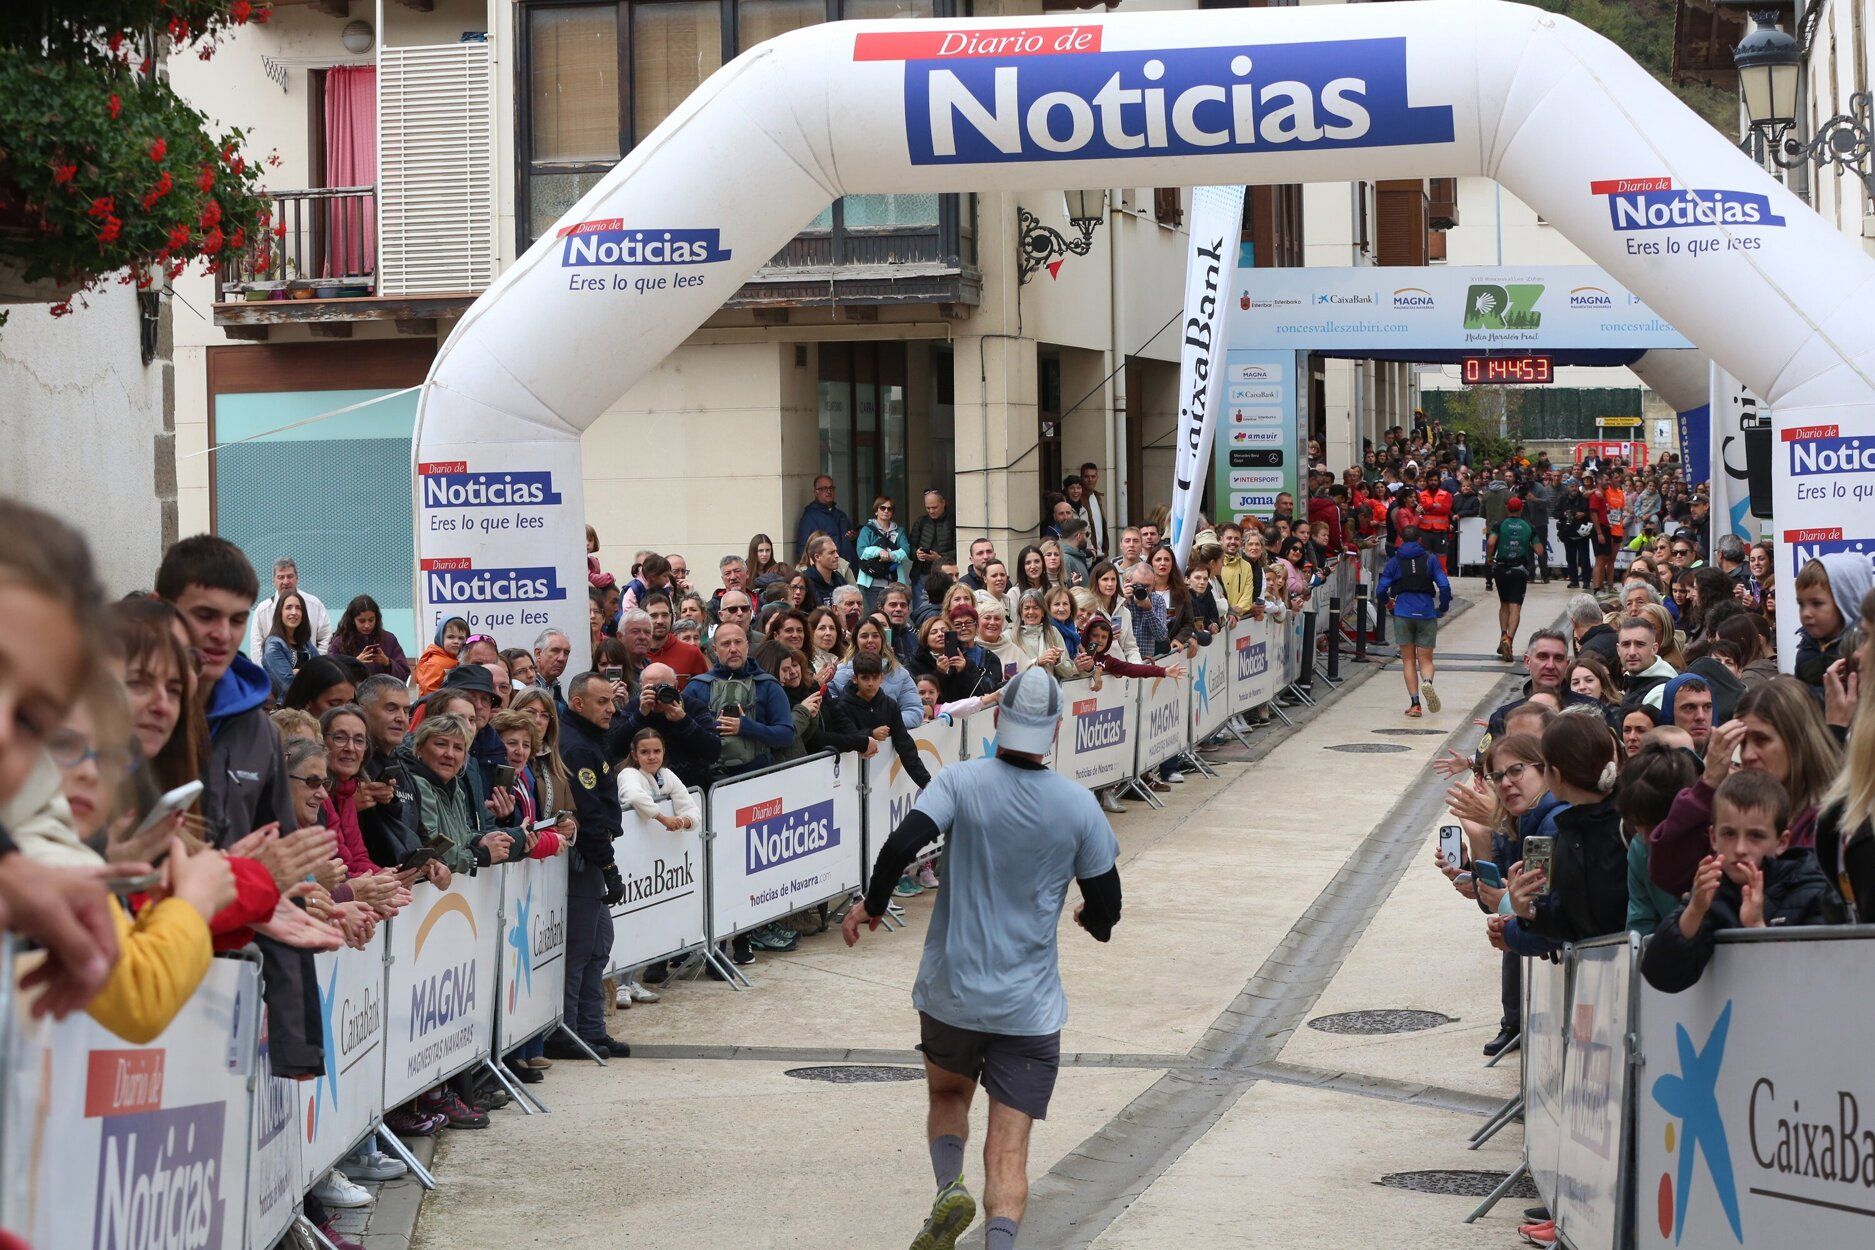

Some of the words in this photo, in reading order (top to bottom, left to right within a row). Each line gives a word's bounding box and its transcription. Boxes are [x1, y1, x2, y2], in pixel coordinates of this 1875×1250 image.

[936, 28, 1044, 57] Diario
[1054, 26, 1092, 53] de
[928, 55, 1371, 156] Noticias
[1617, 181, 1652, 192] Diario
[1655, 178, 1668, 190] de
[1616, 192, 1761, 228] Noticias
[576, 222, 606, 233] Diario
[608, 219, 620, 230] de
[568, 232, 708, 264] Noticias
[1626, 238, 1660, 255] Eres
[1666, 236, 1681, 254] lo
[1687, 238, 1720, 257] que
[568, 274, 607, 291] Eres
[612, 274, 628, 290] lo
[634, 275, 666, 294] que
[673, 272, 705, 288] lees
[1330, 294, 1372, 304] CaixaBank
[1393, 297, 1434, 305] MAGNA
[1570, 296, 1612, 305] MAGNA
[1276, 321, 1409, 334] roncesvalleszubiri.com
[1177, 235, 1225, 492] aixaBank
[1244, 390, 1275, 398] CaixaBank
[1247, 432, 1278, 440] amavir
[1795, 428, 1822, 440] Diario
[1824, 427, 1836, 438] de
[429, 463, 452, 474] Diario
[454, 463, 465, 473] de
[427, 475, 544, 505] Noticias
[1797, 482, 1827, 501] Eres
[1832, 480, 1846, 498] lo
[431, 515, 456, 531] Eres
[461, 514, 474, 530] lo
[480, 516, 510, 534] que
[515, 512, 544, 529] lees
[1799, 530, 1826, 541] Diario
[1828, 529, 1840, 540] de
[432, 559, 456, 570] Diario
[458, 558, 469, 569] de
[431, 571, 549, 601] Noticias
[466, 610, 479, 626] lo
[485, 612, 515, 630] que
[520, 608, 549, 625] lees
[1150, 699, 1180, 740] MAGNA
[1077, 712, 1121, 750] Noticias
[752, 803, 773, 822] Diario
[773, 800, 782, 815] de
[750, 811, 828, 870] Noticias
[779, 883, 789, 897] de
[532, 907, 564, 957] CaixaBank
[409, 958, 476, 1043] MAGNA
[341, 978, 381, 1056] CaixaBank
[407, 1036, 443, 1079] MAGNESITAS
[443, 1024, 475, 1058] NAVARRAS
[112, 1057, 149, 1108] Diario
[149, 1054, 162, 1105] de
[101, 1122, 216, 1250] Noticias
